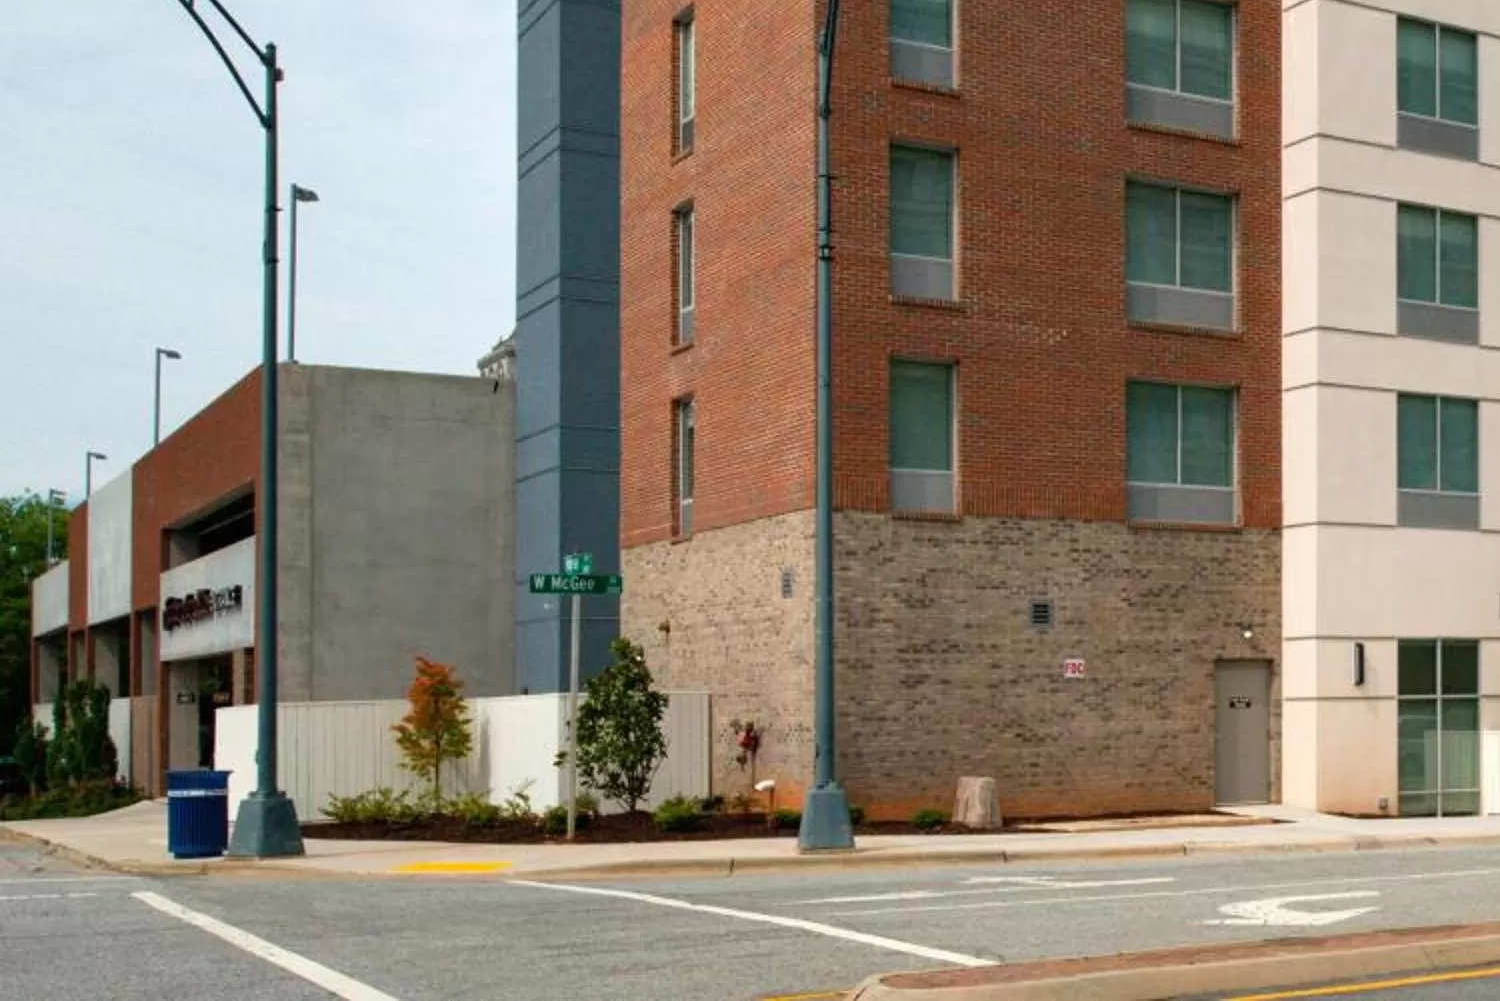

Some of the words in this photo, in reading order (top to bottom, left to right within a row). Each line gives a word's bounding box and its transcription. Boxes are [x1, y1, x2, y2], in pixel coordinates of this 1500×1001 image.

[533, 575, 545, 590] W
[551, 575, 595, 591] McGee
[1064, 662, 1085, 675] FDC
